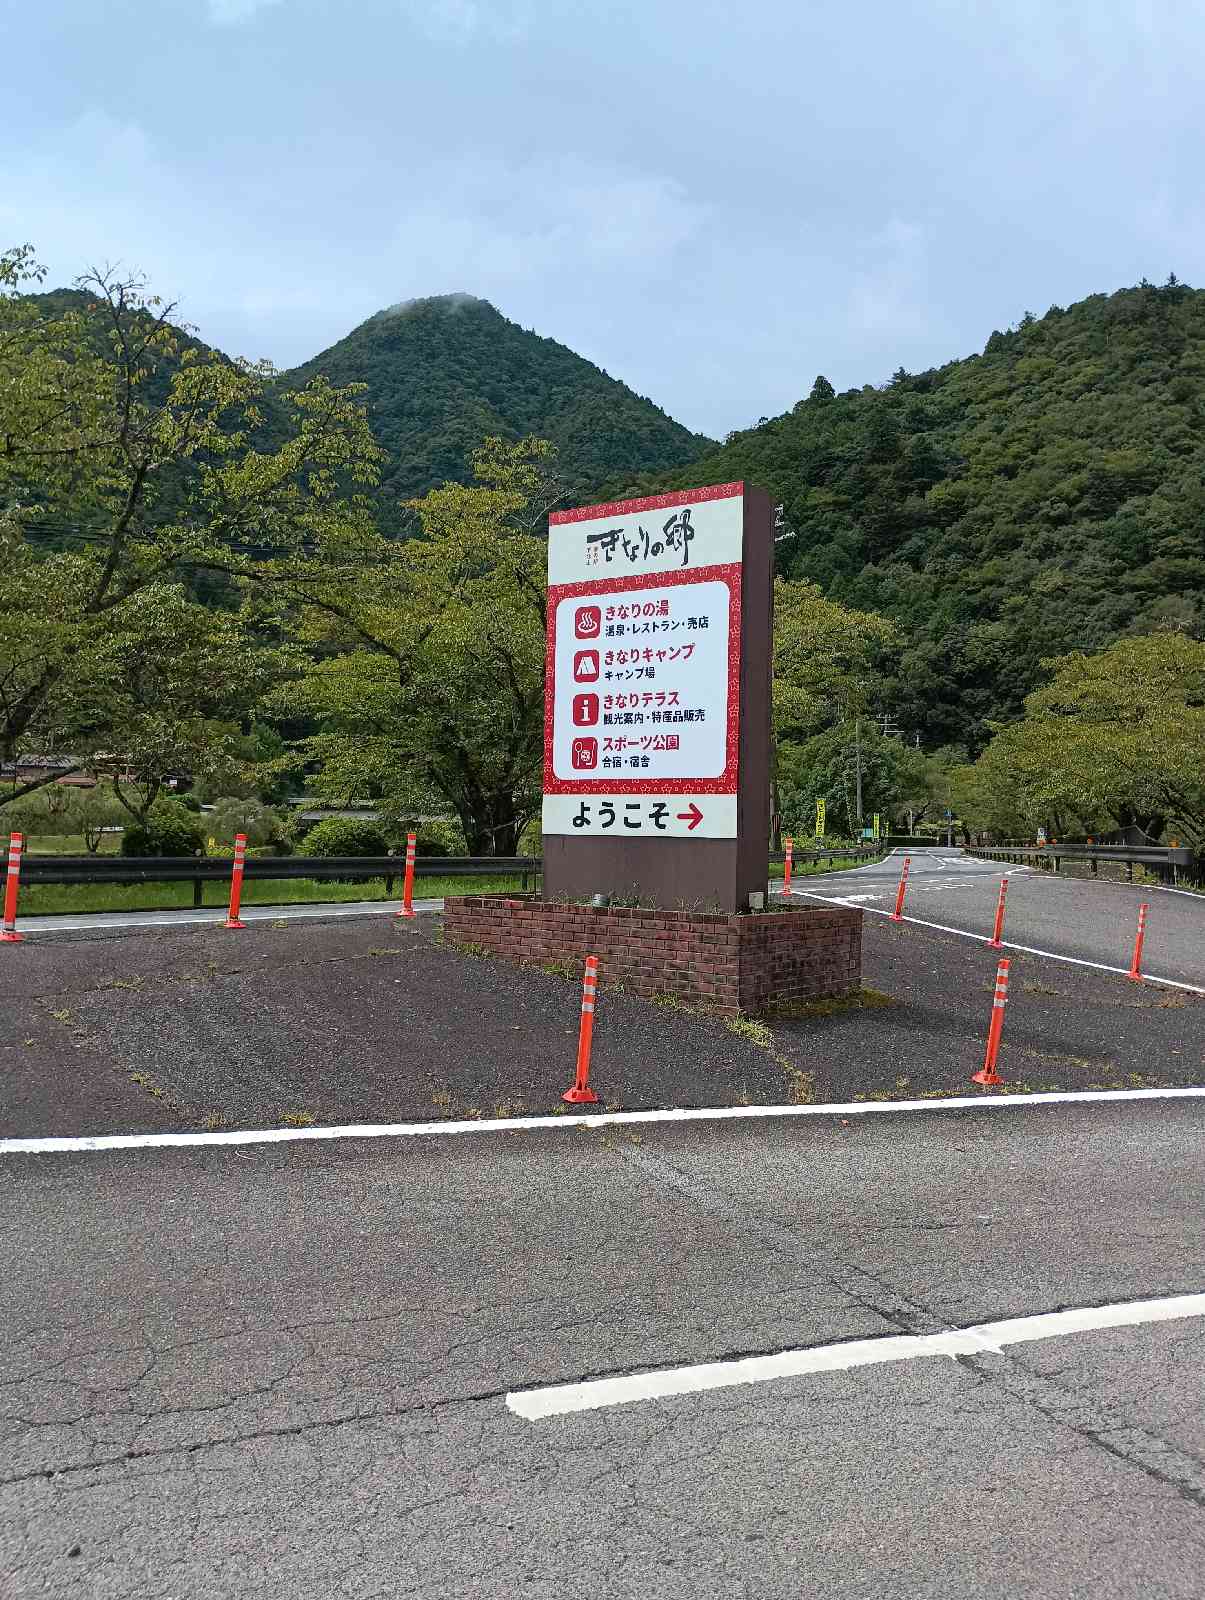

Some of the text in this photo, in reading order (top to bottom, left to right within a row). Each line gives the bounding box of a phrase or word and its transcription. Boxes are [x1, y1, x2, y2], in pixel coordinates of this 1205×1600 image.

[586, 508, 695, 567] きなりの郷
[605, 600, 670, 621] きなりの湯
[605, 616, 709, 637] 温泉・レストラン・売店
[604, 643, 696, 666] きなりキャンプ
[604, 666, 656, 681] キャンプ場
[603, 692, 680, 710] きなりテラス
[603, 709, 706, 725] 観光案内・特産品販売
[602, 735, 680, 752] スポーツ公園
[602, 755, 651, 769] 合宿・宿舎
[572, 801, 670, 830] ようこそ
